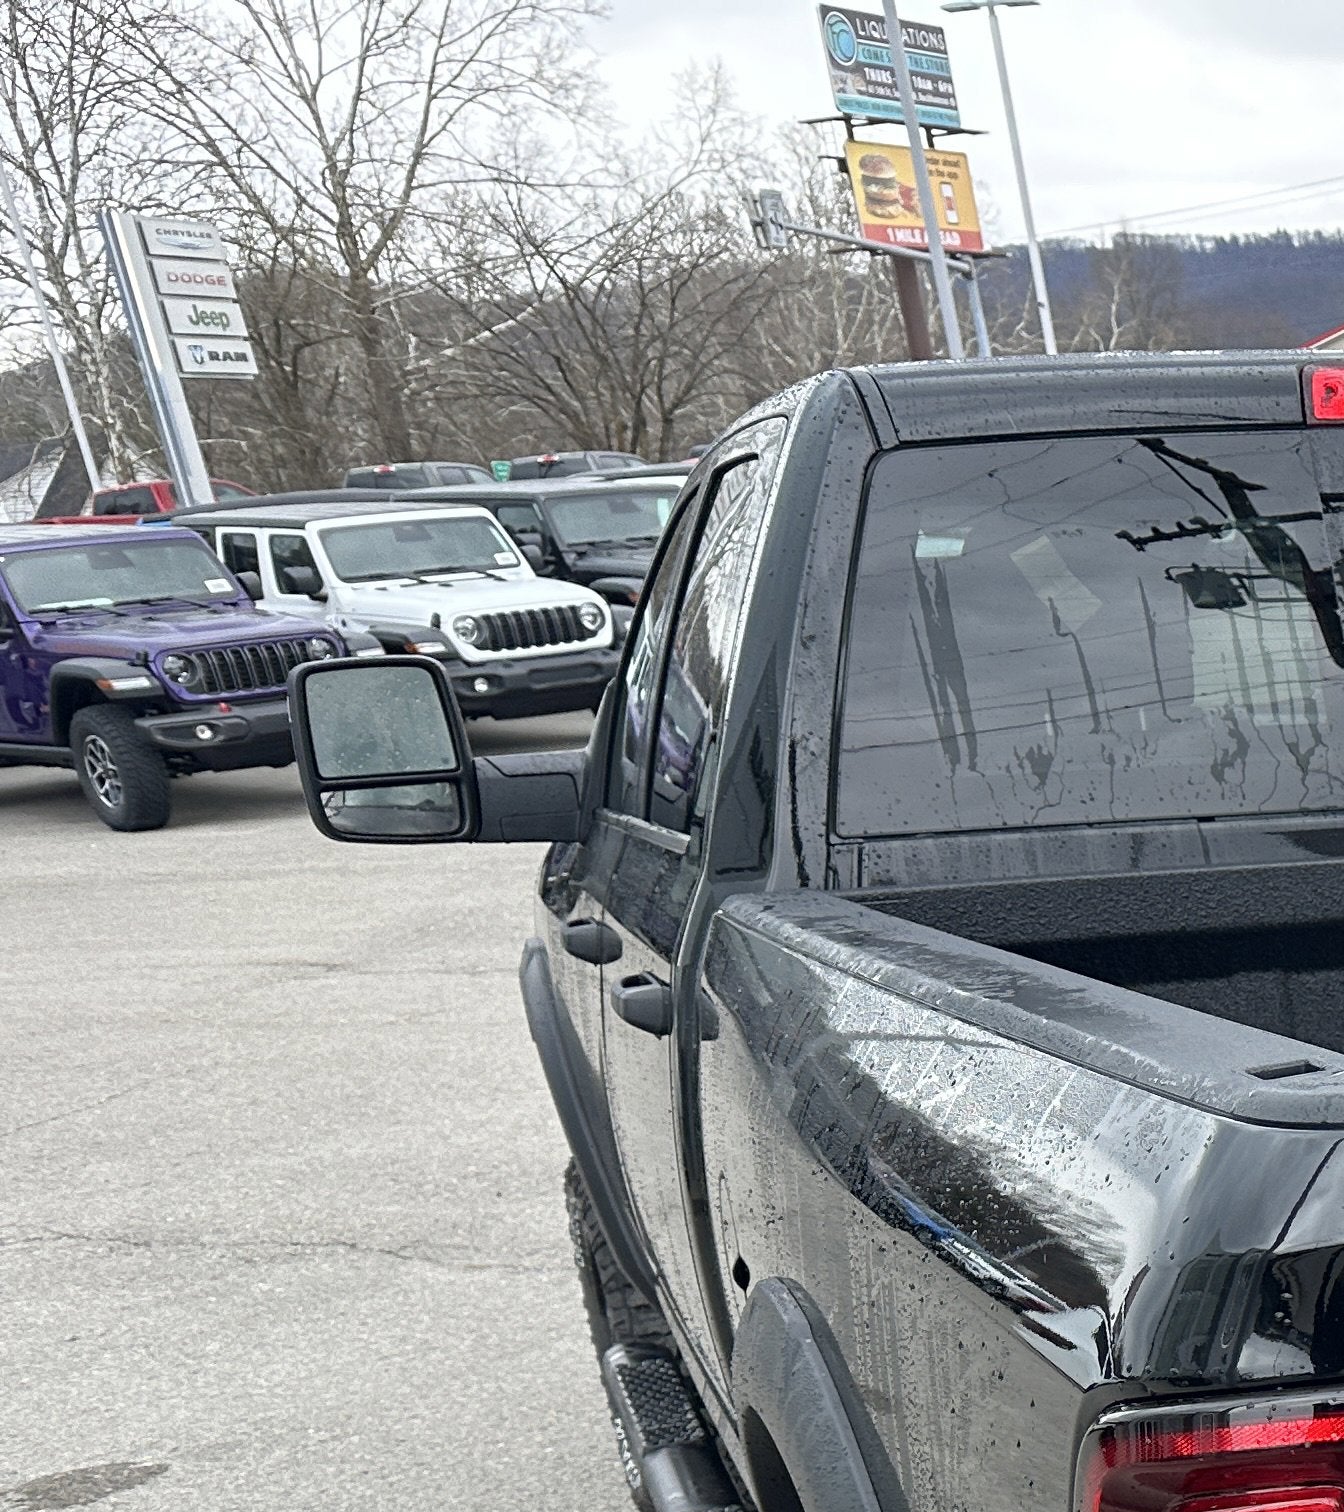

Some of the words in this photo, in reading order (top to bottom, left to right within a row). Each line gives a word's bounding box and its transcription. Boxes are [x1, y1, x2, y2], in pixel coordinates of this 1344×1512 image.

[155, 228, 213, 240] CHRYSLER
[166, 272, 226, 287] DODGE
[187, 304, 230, 331] Jeep
[208, 350, 249, 363] RAM
